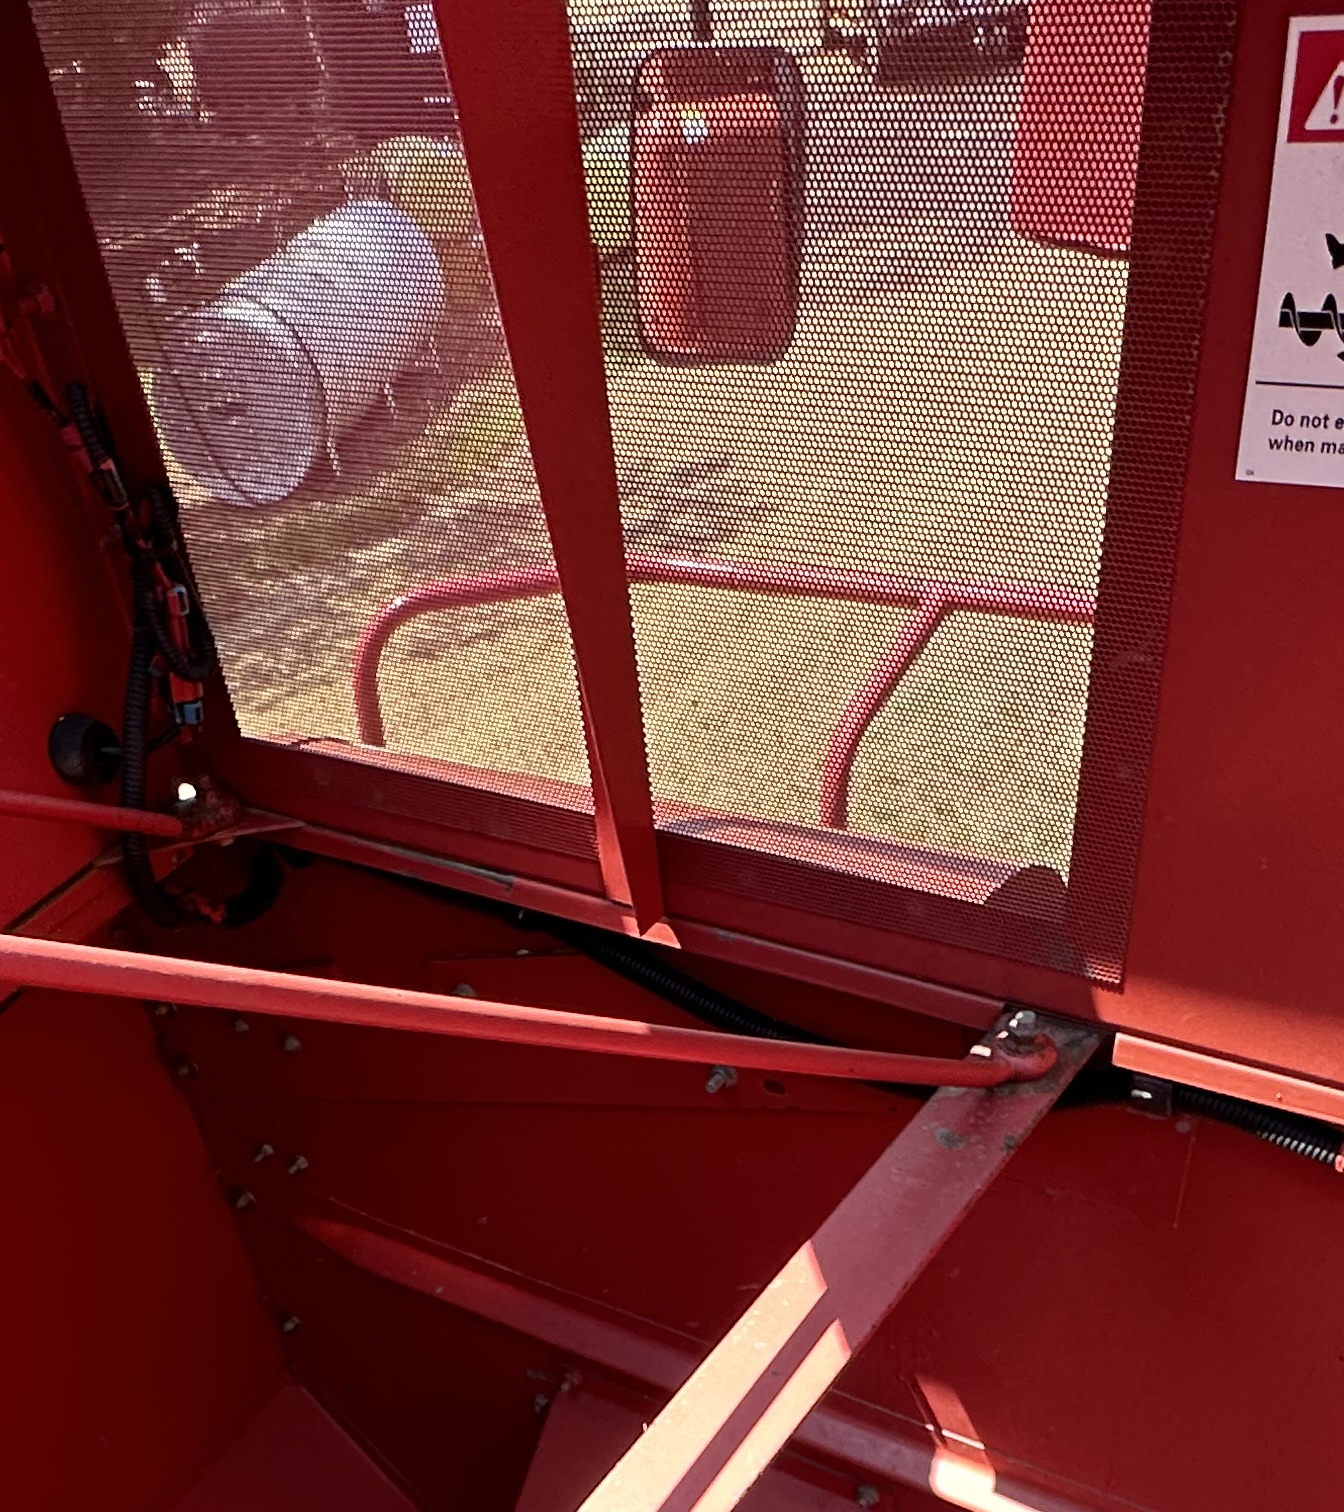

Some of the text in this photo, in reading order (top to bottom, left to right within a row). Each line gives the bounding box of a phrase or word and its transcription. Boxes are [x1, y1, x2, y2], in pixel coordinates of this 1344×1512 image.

[1271, 409, 1295, 427] Do
[1299, 413, 1330, 430] not
[1267, 435, 1315, 454] when
